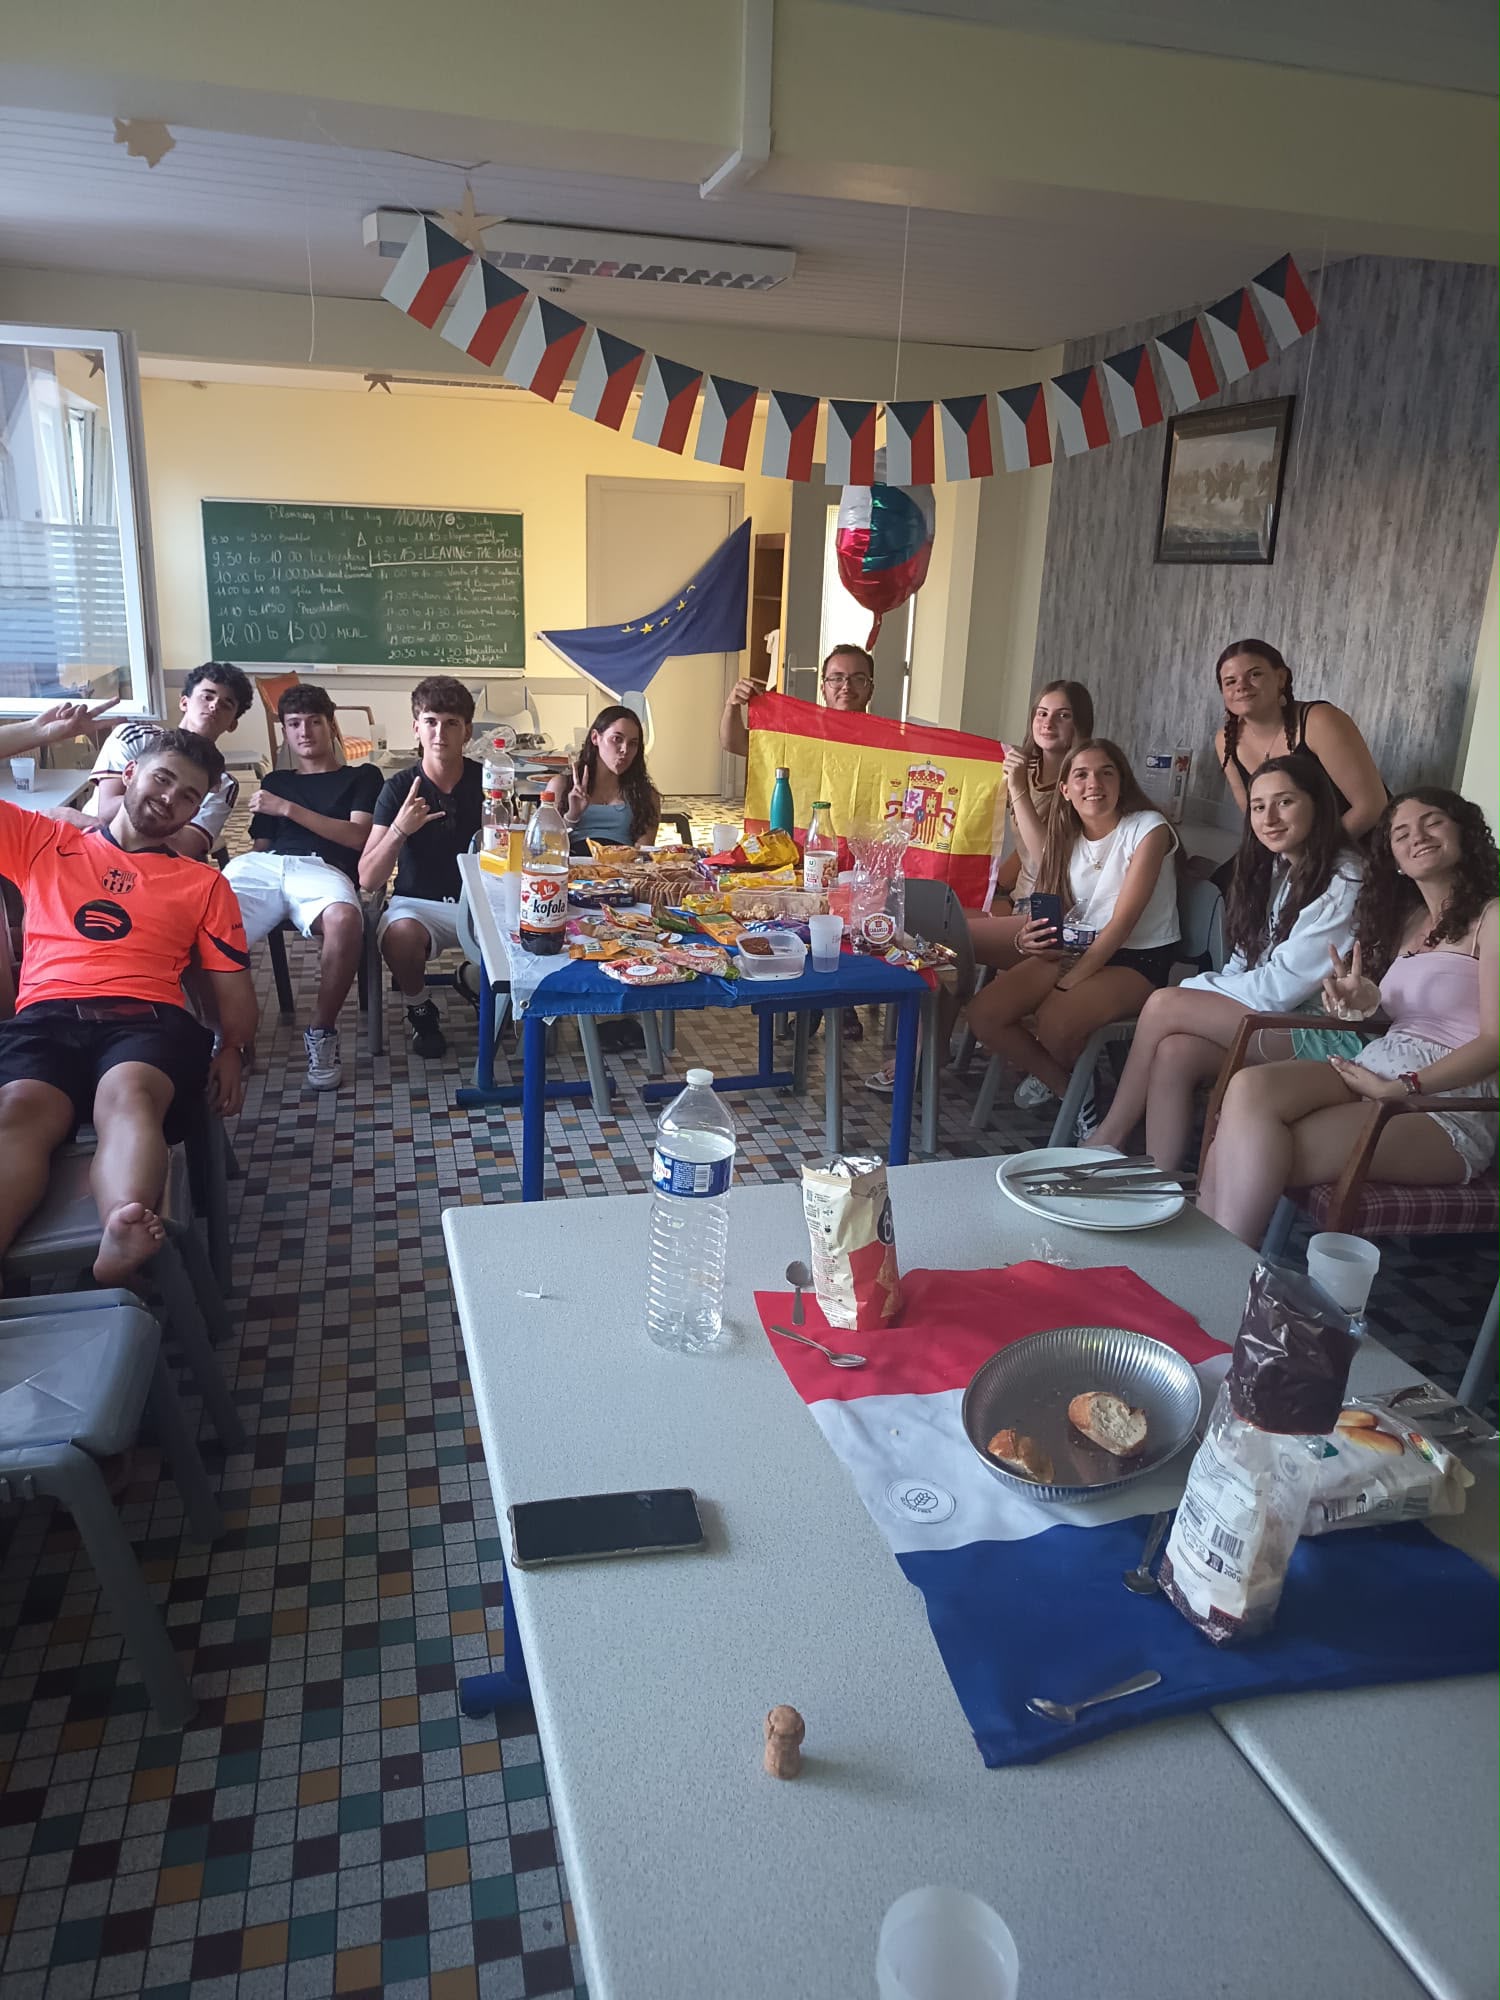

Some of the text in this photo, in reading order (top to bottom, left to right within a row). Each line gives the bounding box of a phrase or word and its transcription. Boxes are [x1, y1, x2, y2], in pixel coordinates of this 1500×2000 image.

[211, 550, 243, 568] 9.30
[249, 551, 261, 565] to
[422, 544, 474, 561] LEAVING
[254, 567, 266, 583] to
[265, 622, 280, 641] to
[532, 899, 567, 918] kofola
